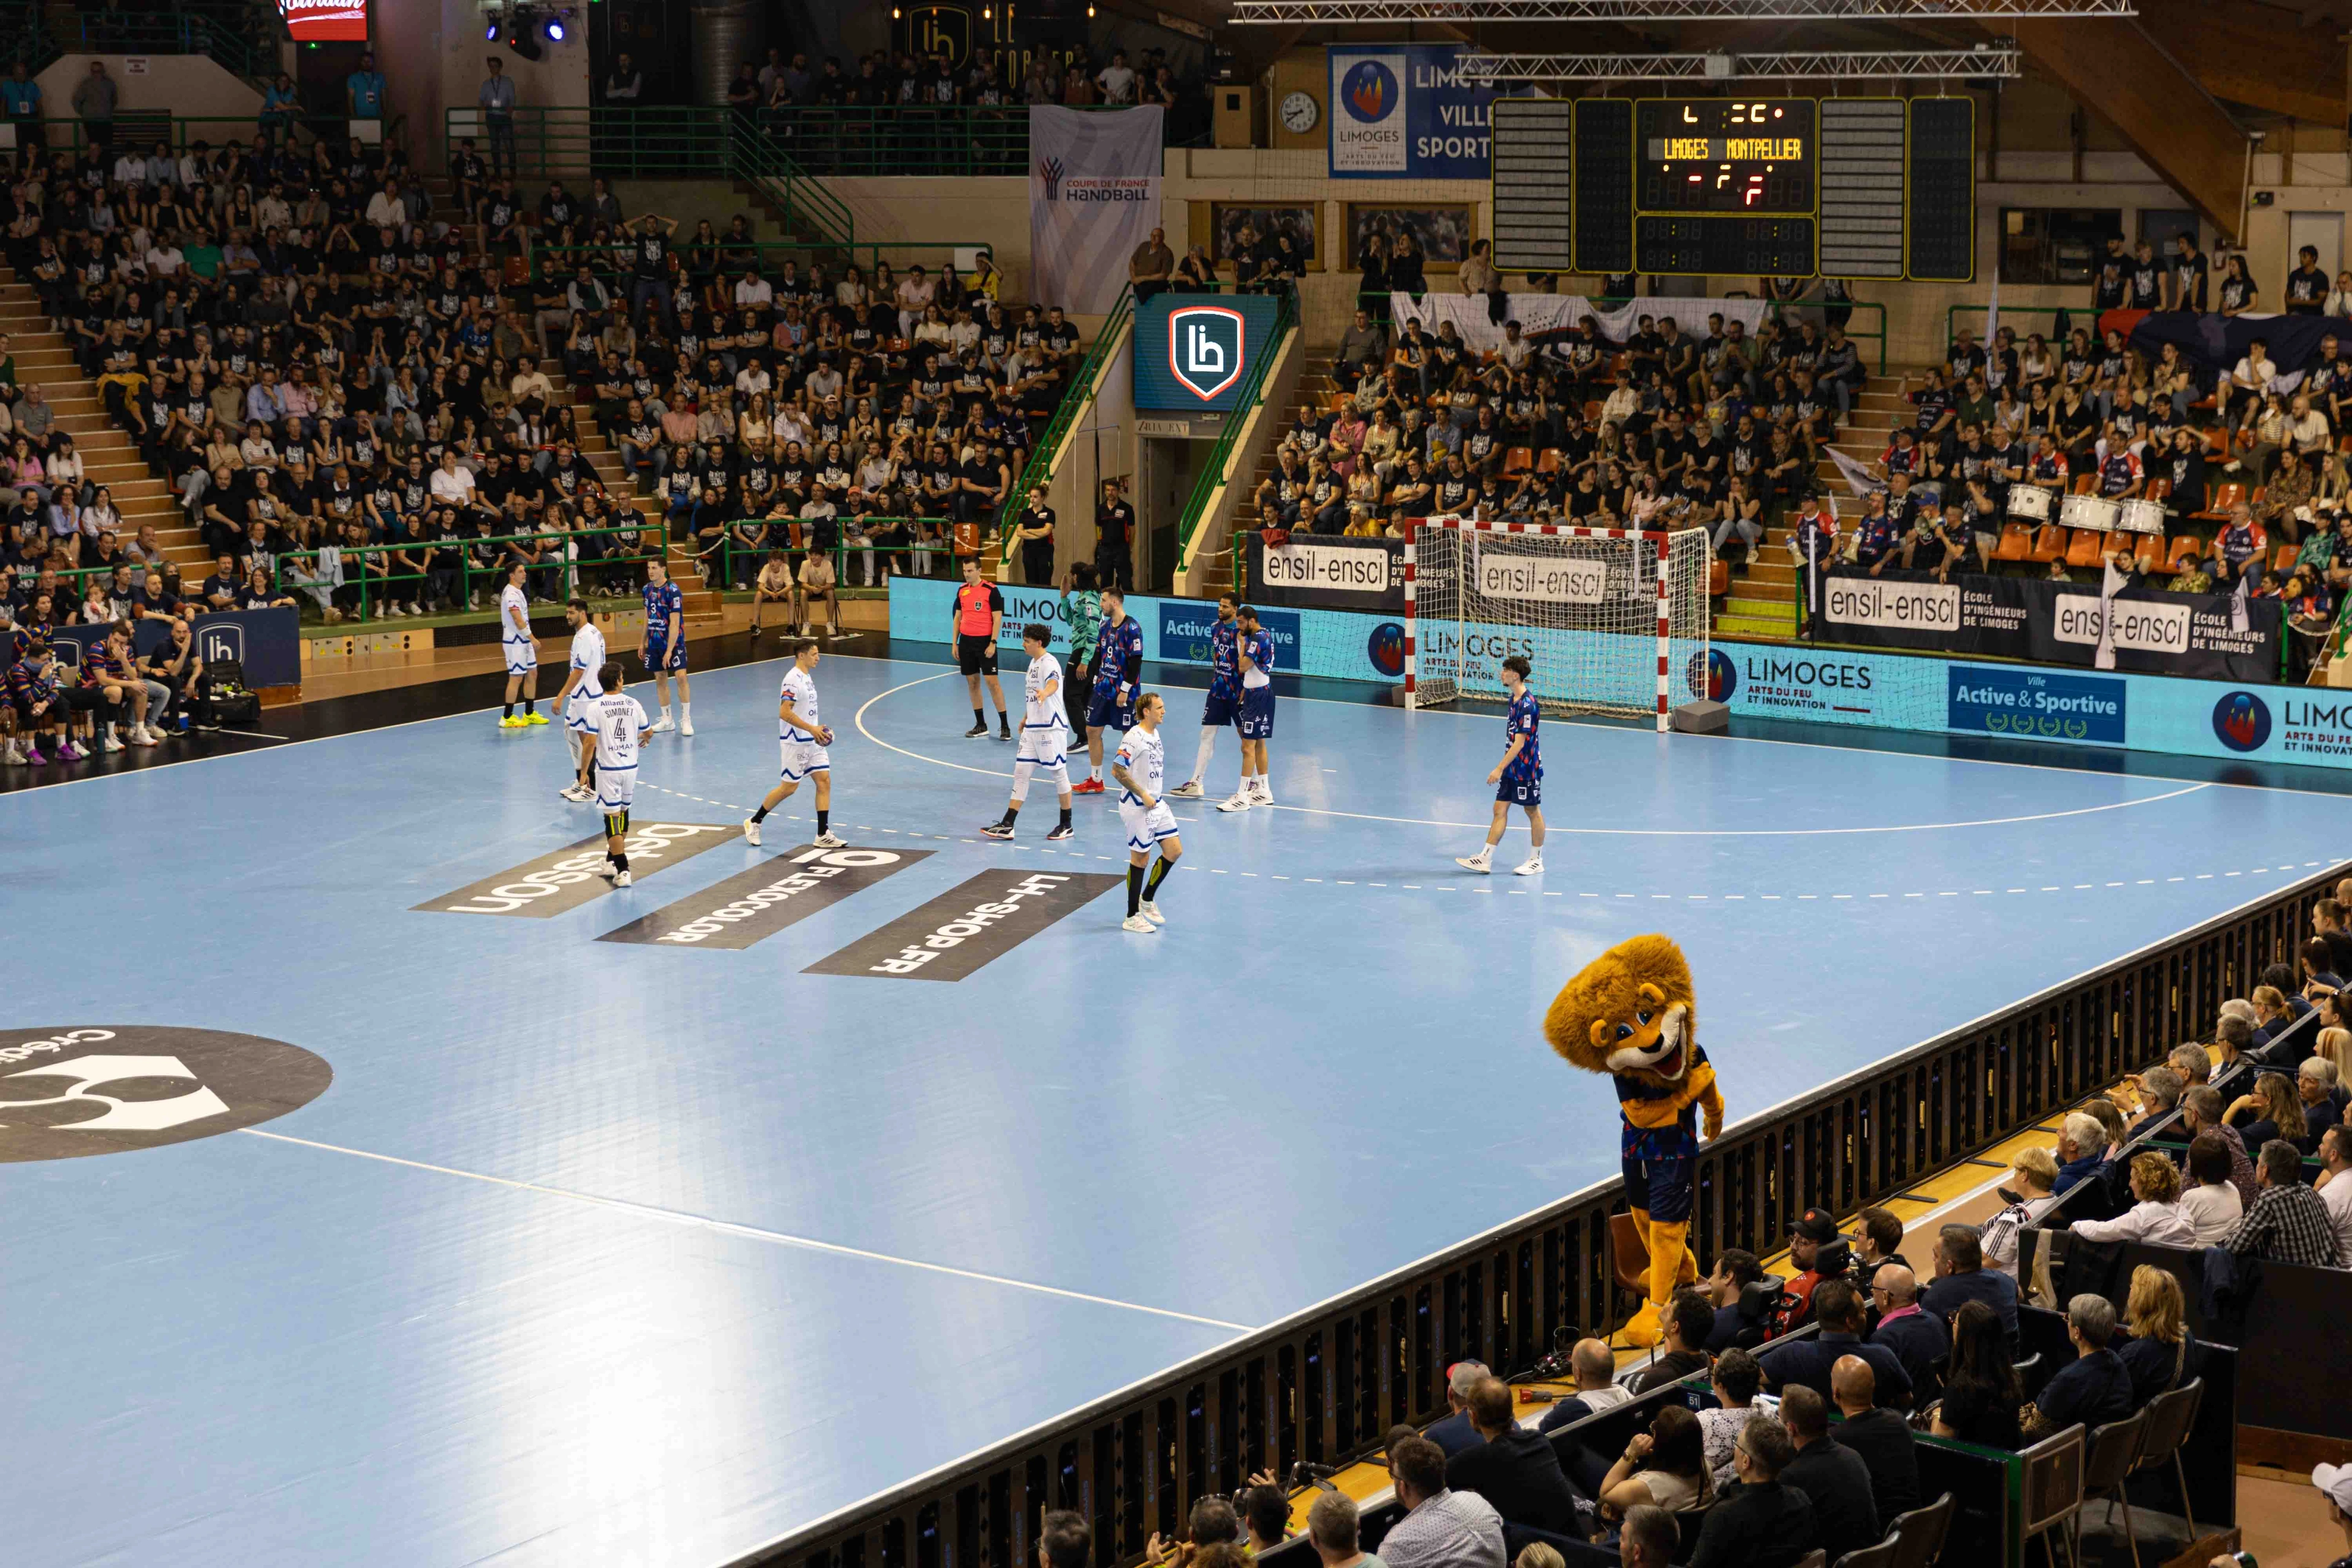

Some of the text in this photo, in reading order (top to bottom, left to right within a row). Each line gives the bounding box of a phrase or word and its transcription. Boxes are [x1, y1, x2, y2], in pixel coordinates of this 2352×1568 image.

[1340, 131, 1399, 143] LIMOGES
[1664, 138, 1801, 160] LIMOGES MONTPELLIER
[1268, 551, 1382, 584] ensil-ensci
[1391, 578, 1401, 586] DE
[1487, 562, 1600, 597] ensil-ensci
[1964, 590, 1992, 603] ÉCOLE
[650, 603, 657, 614] 3
[1831, 586, 1954, 623] ensil-ensci
[1963, 604, 2027, 619] D'INGÉNIEURS
[1963, 617, 1976, 626] DE
[1980, 617, 2019, 630] LIMOGES
[2194, 612, 2226, 626] ÉCOLE
[1002, 622, 1021, 630] ARTS
[1166, 620, 1212, 638] Active
[2061, 611, 2184, 644] ens-ensci
[1219, 644, 1229, 656] 97
[1424, 631, 1534, 661] LIMOGES
[2192, 638, 2205, 649] DE
[2209, 639, 2254, 654] LIMOGES
[1107, 646, 1113, 658] 9
[1425, 658, 1447, 667] ARTS
[1748, 658, 1871, 690] LIMOGES
[2027, 676, 2046, 687] Ville
[1748, 685, 1812, 698] ARTS DU FEU
[1748, 695, 1826, 709] ET INNOVATION
[1956, 685, 2117, 715] Active & Sportive
[605, 707, 634, 718] SIMONET
[614, 718, 627, 742] 4
[2285, 731, 2313, 741] ARTS
[2319, 734, 2334, 742] DU
[657, 865, 846, 943] FLEXOCOLOR
[869, 874, 1071, 973] LH-SHOP.FR
[1689, 1396, 1698, 1406] 51
